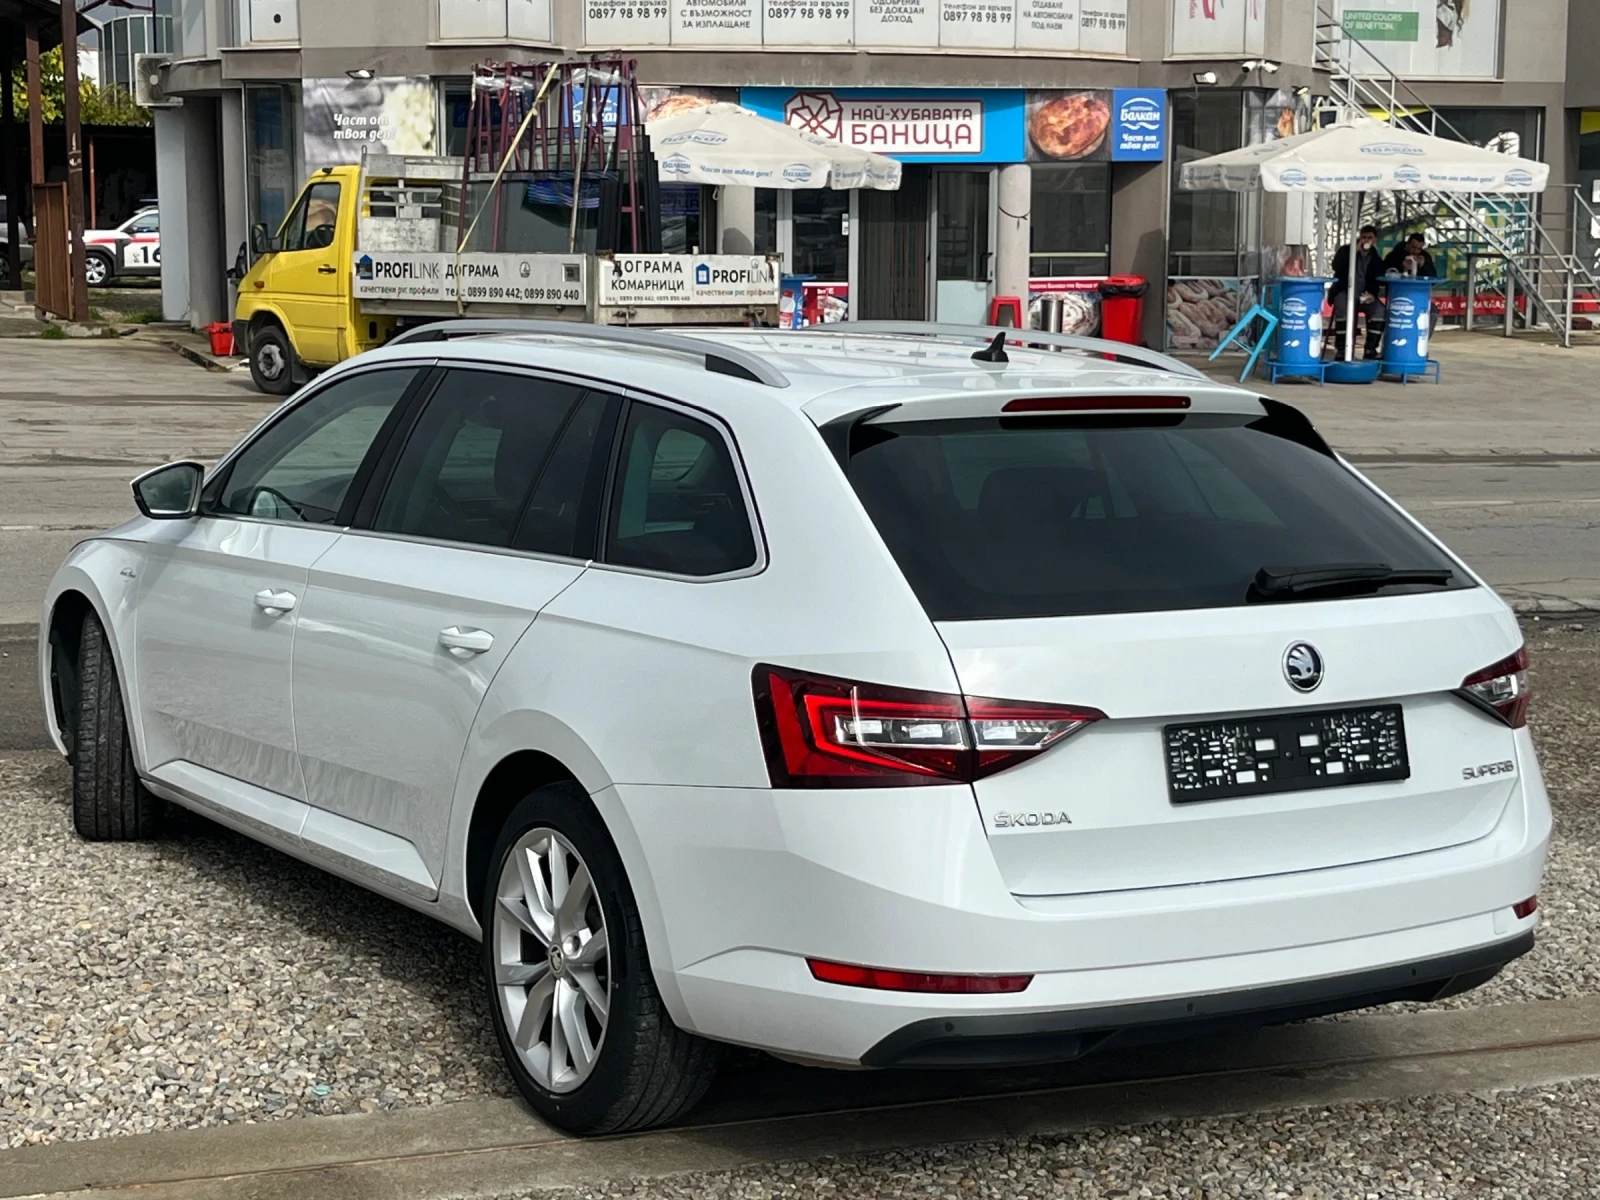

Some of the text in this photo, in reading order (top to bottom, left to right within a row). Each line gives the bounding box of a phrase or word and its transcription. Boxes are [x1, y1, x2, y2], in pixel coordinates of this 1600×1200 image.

[589, 8, 667, 19] 0897 98 98 99
[690, 9, 752, 17] ВЪЗМОЖНОСТ
[768, 8, 849, 19] 0897 98 98 99
[881, 14, 913, 23] ДОХОД
[944, 11, 1011, 23] 0897 98 98 99
[1344, 12, 1402, 21] UNITED COLORS
[682, 20, 693, 28] ЗА
[1344, 21, 1353, 29] OF
[851, 104, 973, 121] НАЙ-ХУБАВАТА
[1120, 108, 1160, 121] Балкан
[333, 113, 389, 126] Част от
[333, 128, 367, 139] твоя
[851, 123, 972, 149] БАНИЦА
[1122, 133, 1143, 141] Част
[375, 262, 440, 279] PROFILINK
[445, 264, 499, 279] ДОГРАМА
[612, 261, 683, 276] ДОГРАМА
[611, 279, 685, 293] КОМАРНИЦИ
[467, 286, 487, 297] 0899
[489, 287, 503, 298] 890
[505, 287, 523, 299] 442;
[524, 287, 545, 299] 0899
[547, 288, 561, 300] 890
[563, 289, 580, 300] 440
[1462, 760, 1514, 780] SUPERB
[994, 810, 1072, 828] ŠKODA
